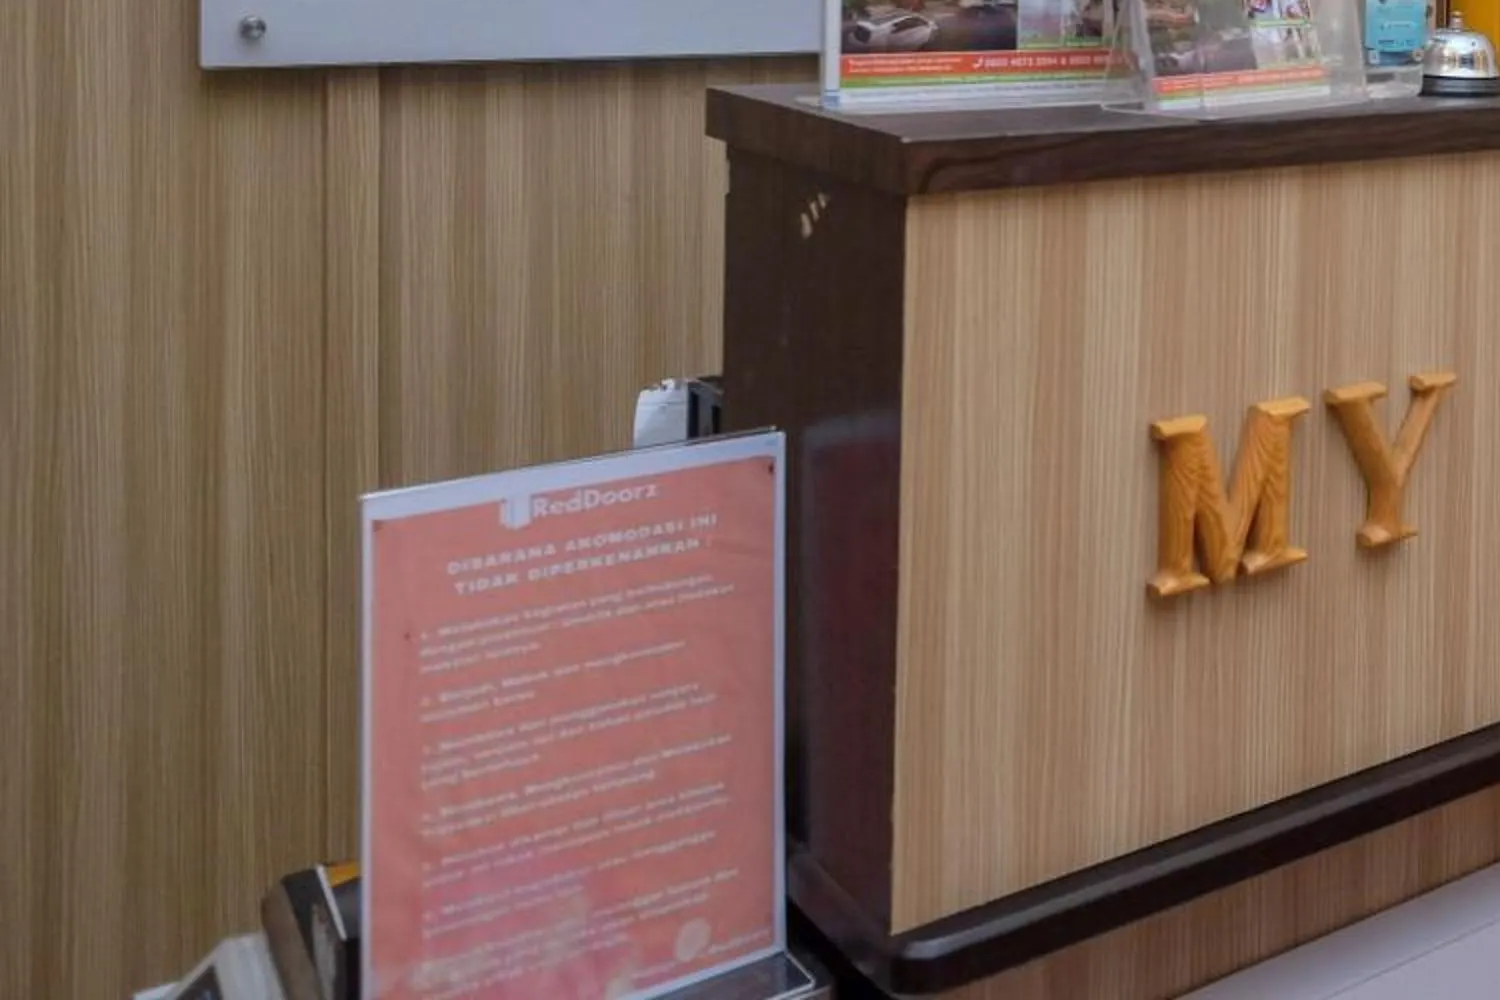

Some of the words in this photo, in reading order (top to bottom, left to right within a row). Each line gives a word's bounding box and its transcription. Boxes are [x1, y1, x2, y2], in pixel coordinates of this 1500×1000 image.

[533, 483, 658, 519] RedDoorz
[1145, 370, 1456, 597] MY
[454, 572, 520, 596] TIDAK
